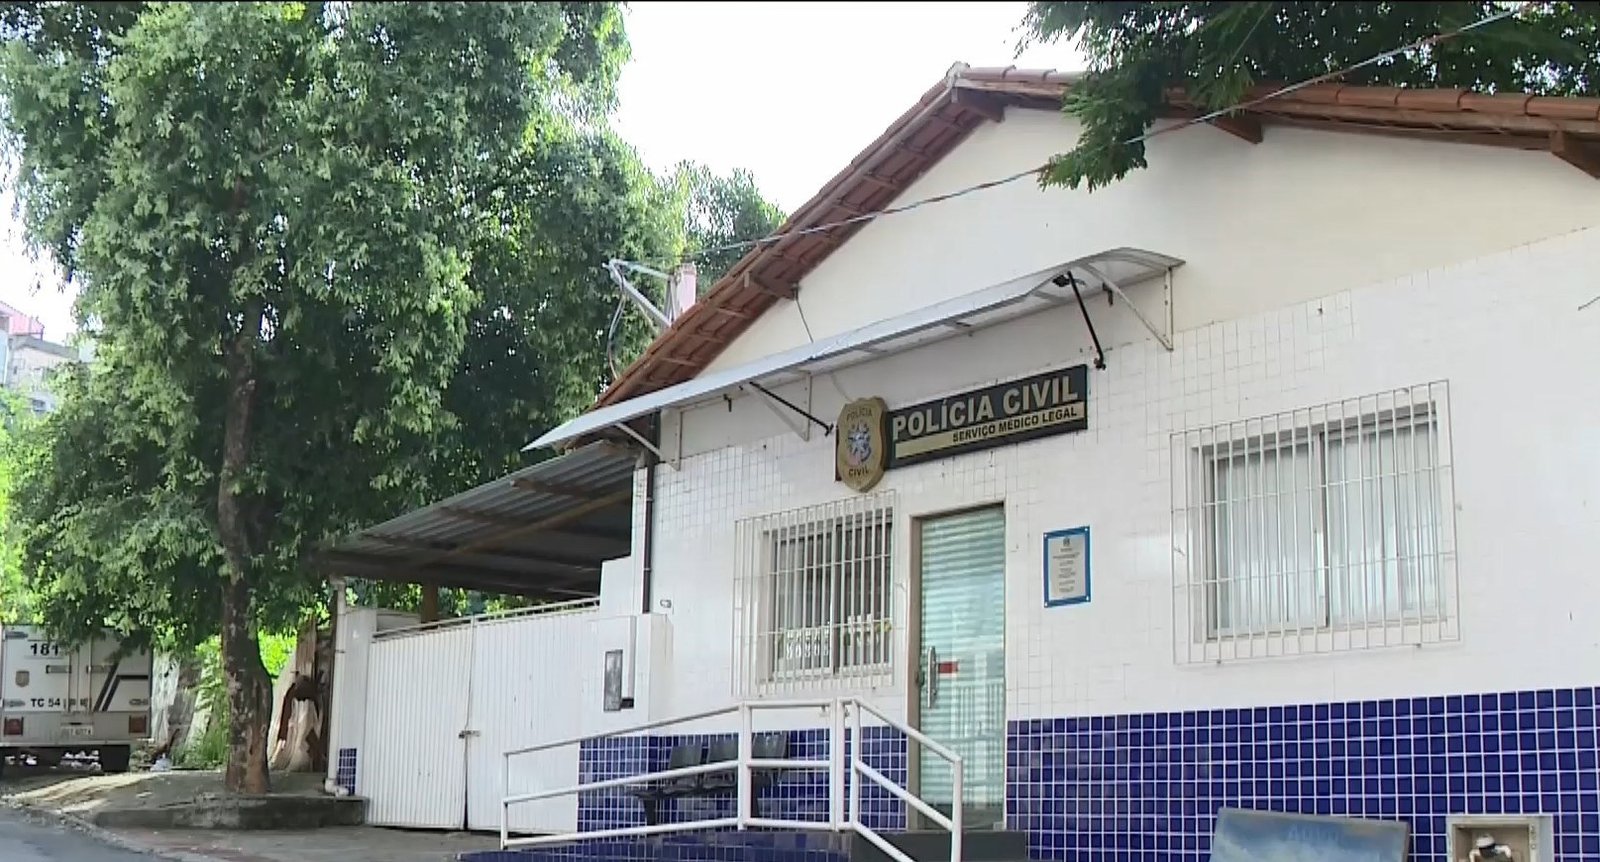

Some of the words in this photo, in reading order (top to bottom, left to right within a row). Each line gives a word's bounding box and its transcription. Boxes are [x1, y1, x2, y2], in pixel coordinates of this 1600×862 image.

[892, 395, 994, 440] POLÍCIA
[1003, 376, 1078, 415] CIVIL
[1043, 407, 1077, 423] LEGAL
[848, 466, 869, 478] CIVIL
[30, 643, 59, 656] 181
